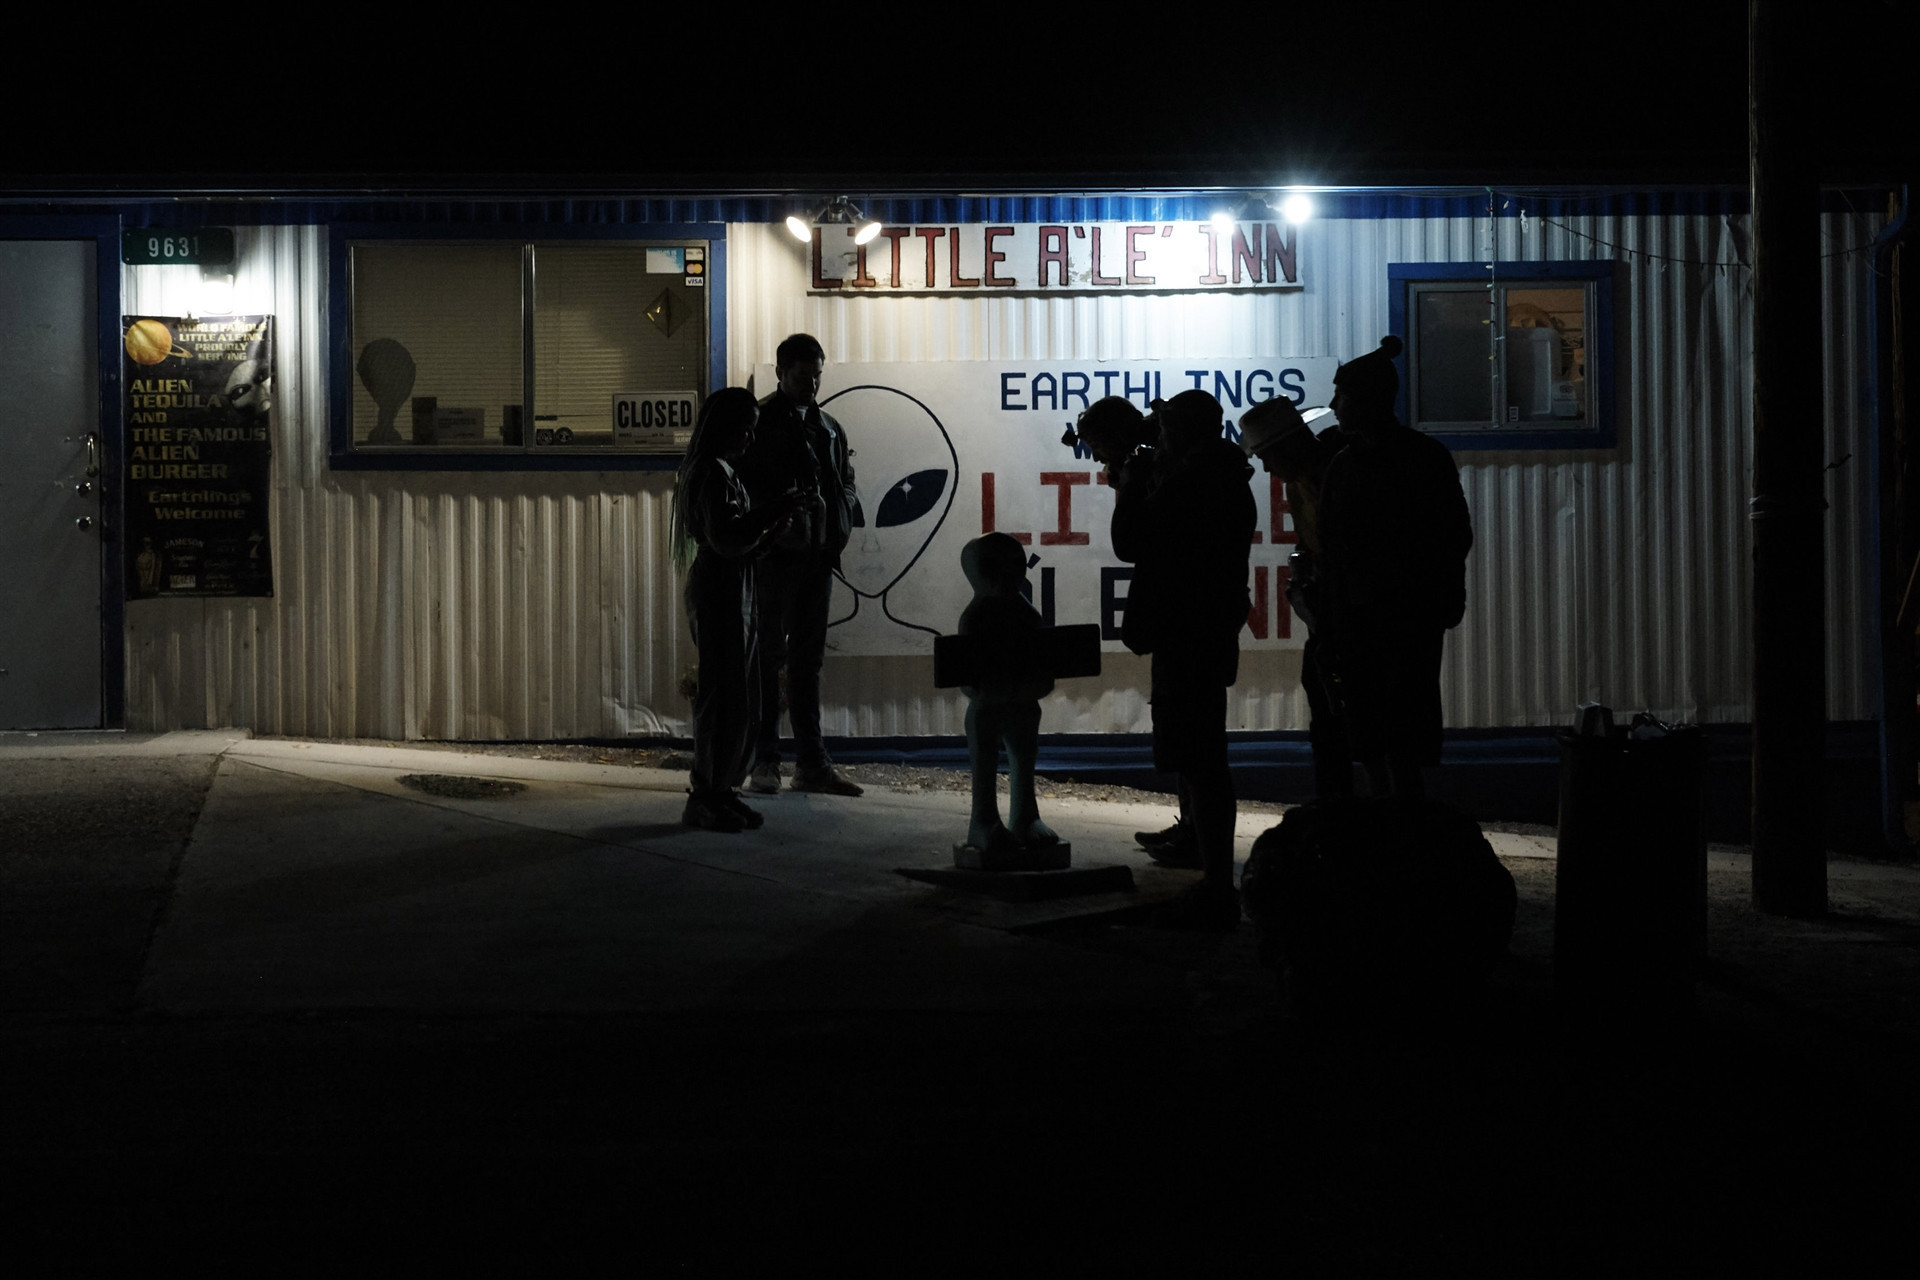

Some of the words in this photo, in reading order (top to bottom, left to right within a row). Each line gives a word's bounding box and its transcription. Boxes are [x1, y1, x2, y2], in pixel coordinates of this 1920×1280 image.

[812, 226, 1016, 289] LITTLE
[1198, 223, 1297, 284] INN
[179, 333, 216, 342] LITTLE
[195, 343, 248, 351] PROUDLY
[198, 352, 247, 361] SERVING
[130, 378, 193, 394] ALIEN
[130, 394, 222, 409] TEQUILA
[130, 411, 168, 423] AND
[617, 400, 692, 428] CLOSED
[131, 427, 173, 442] THE
[176, 427, 267, 442] FAMOUS
[131, 445, 200, 461] ALIEN
[131, 463, 228, 480] BURGER
[148, 489, 253, 506] Earthlings
[154, 506, 246, 520] Welcome
